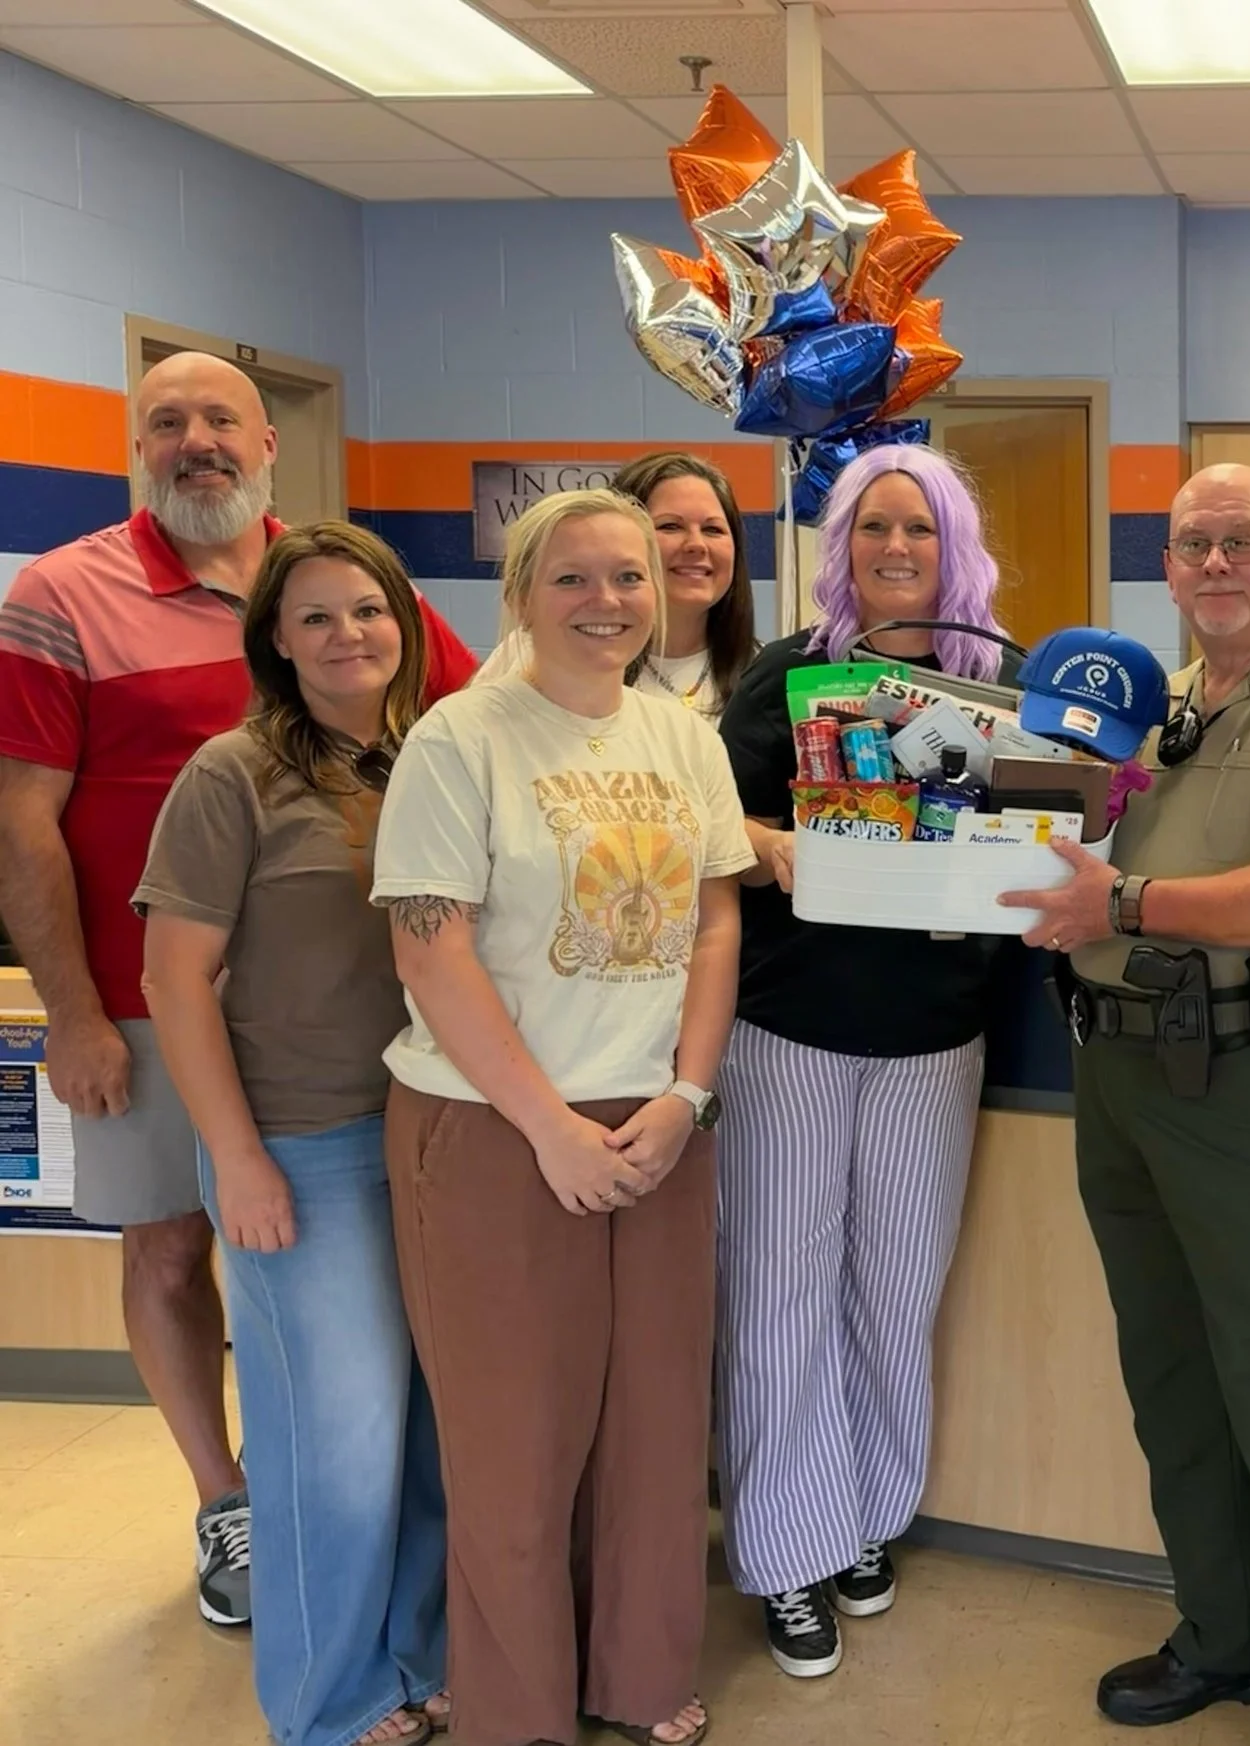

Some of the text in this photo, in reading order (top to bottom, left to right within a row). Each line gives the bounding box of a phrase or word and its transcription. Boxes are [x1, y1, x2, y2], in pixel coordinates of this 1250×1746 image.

[511, 467, 618, 496] IN GO
[1052, 653, 1085, 685] CENTER
[1086, 652, 1120, 669] POINT
[1117, 666, 1133, 709] CHURCH
[577, 799, 669, 825] GRACE
